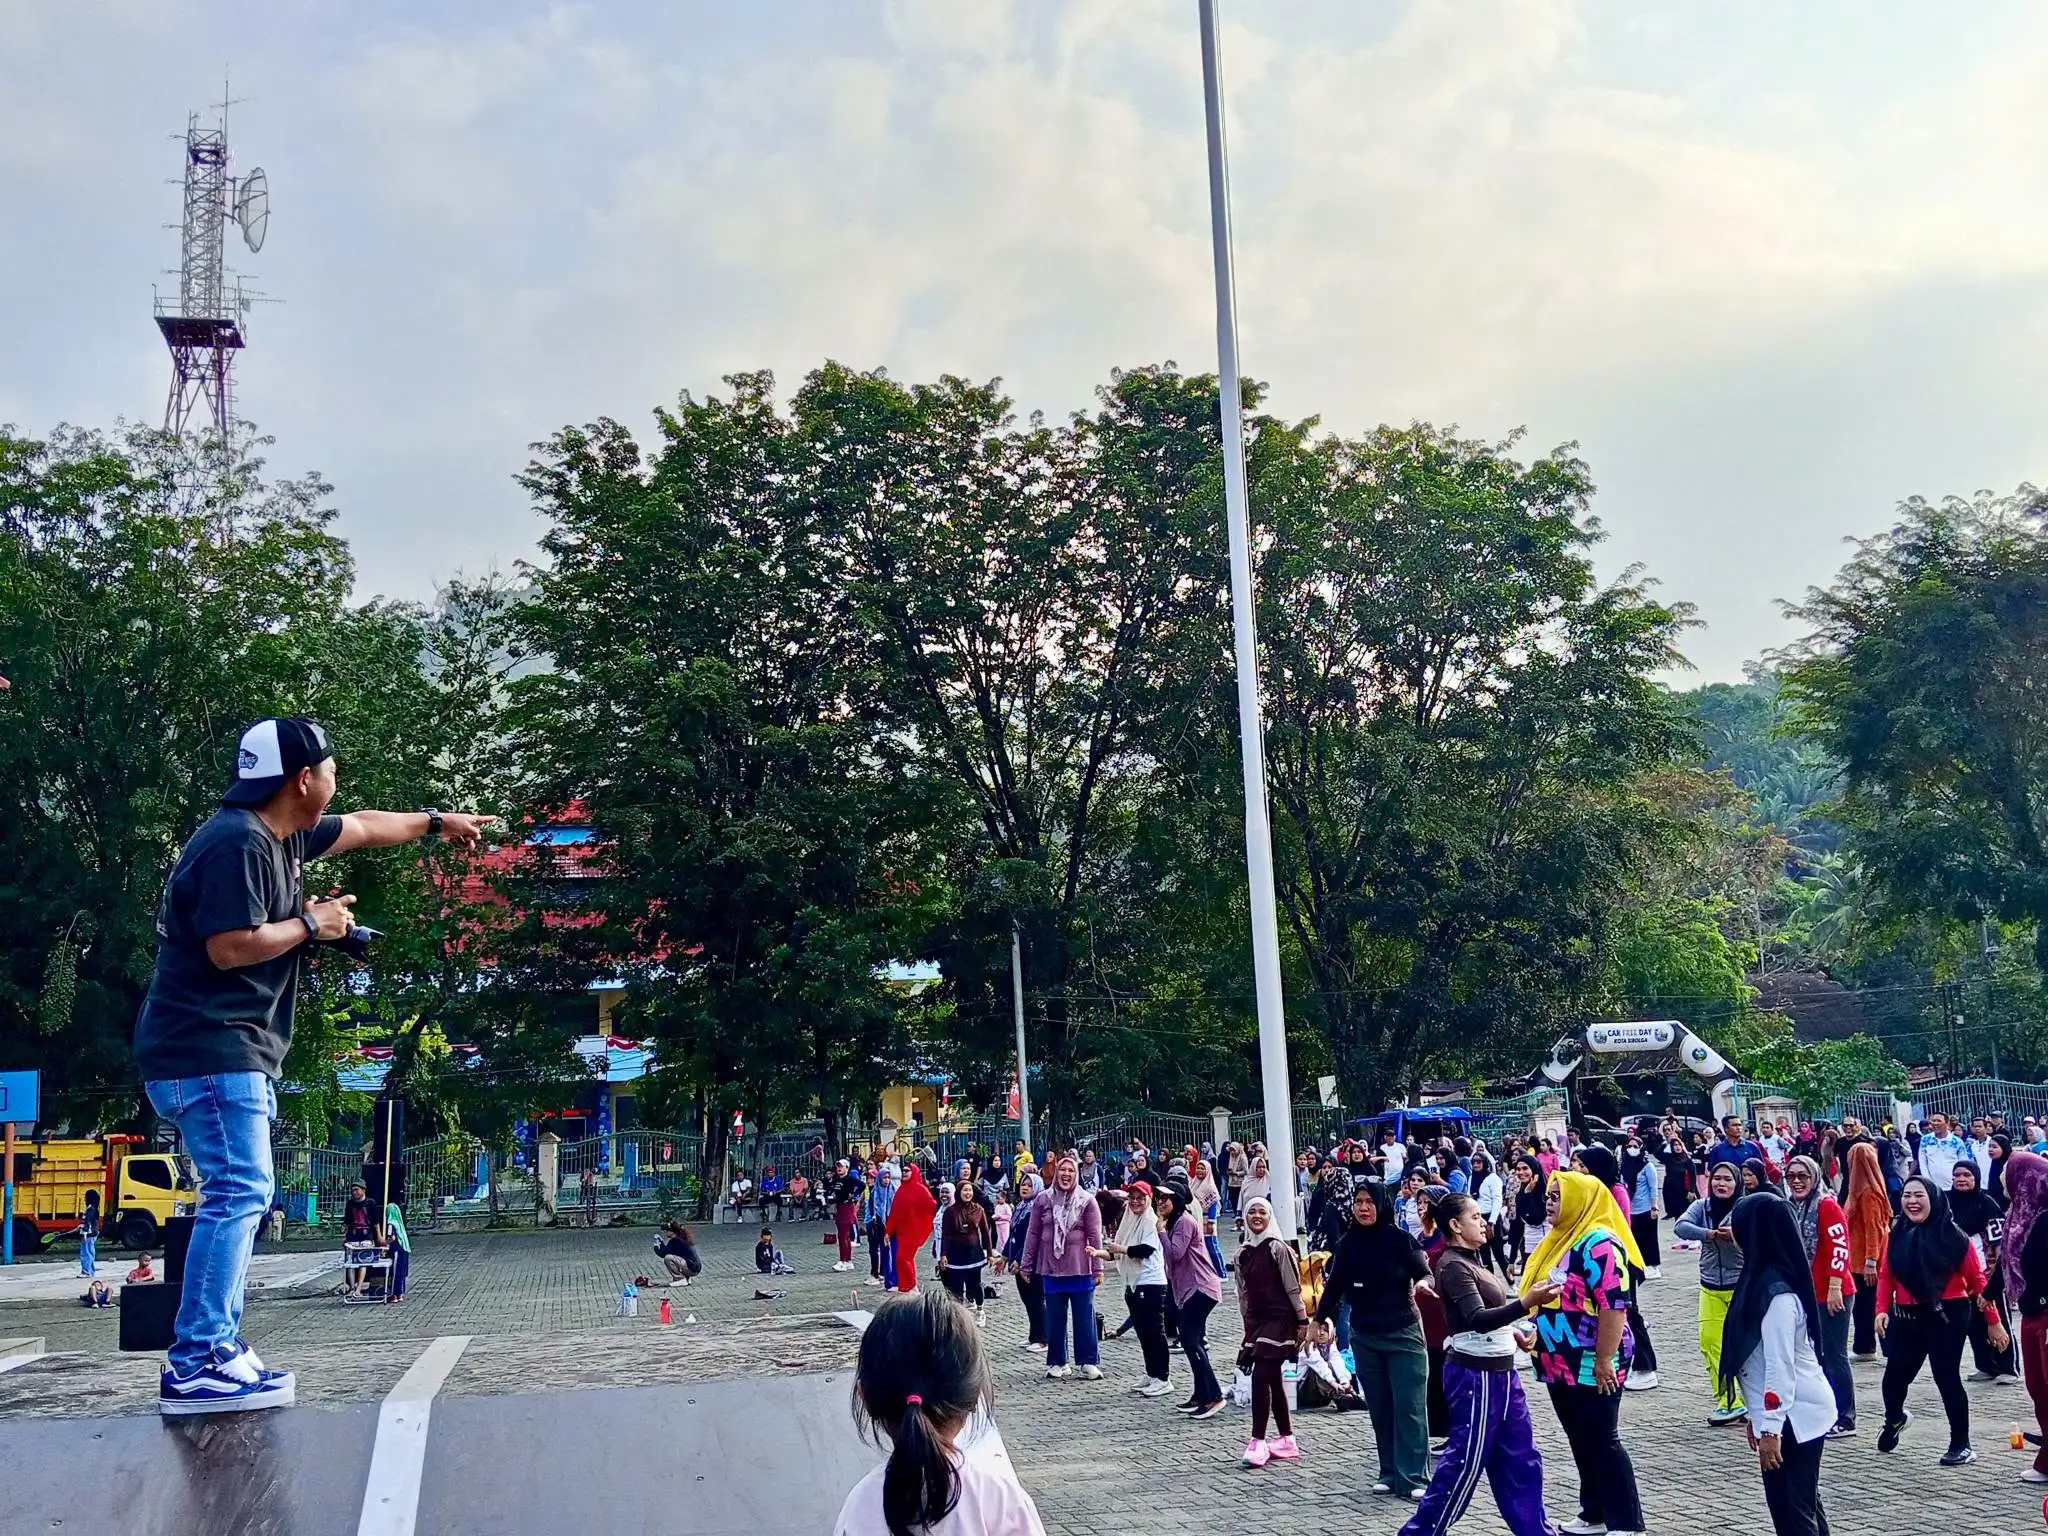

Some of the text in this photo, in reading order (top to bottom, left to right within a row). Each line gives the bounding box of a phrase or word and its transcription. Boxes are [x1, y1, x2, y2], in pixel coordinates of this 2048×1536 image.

[1607, 1029, 1621, 1037] CAR
[1638, 1028, 1652, 1036] DAY
[1827, 1223, 1849, 1272] EYES
